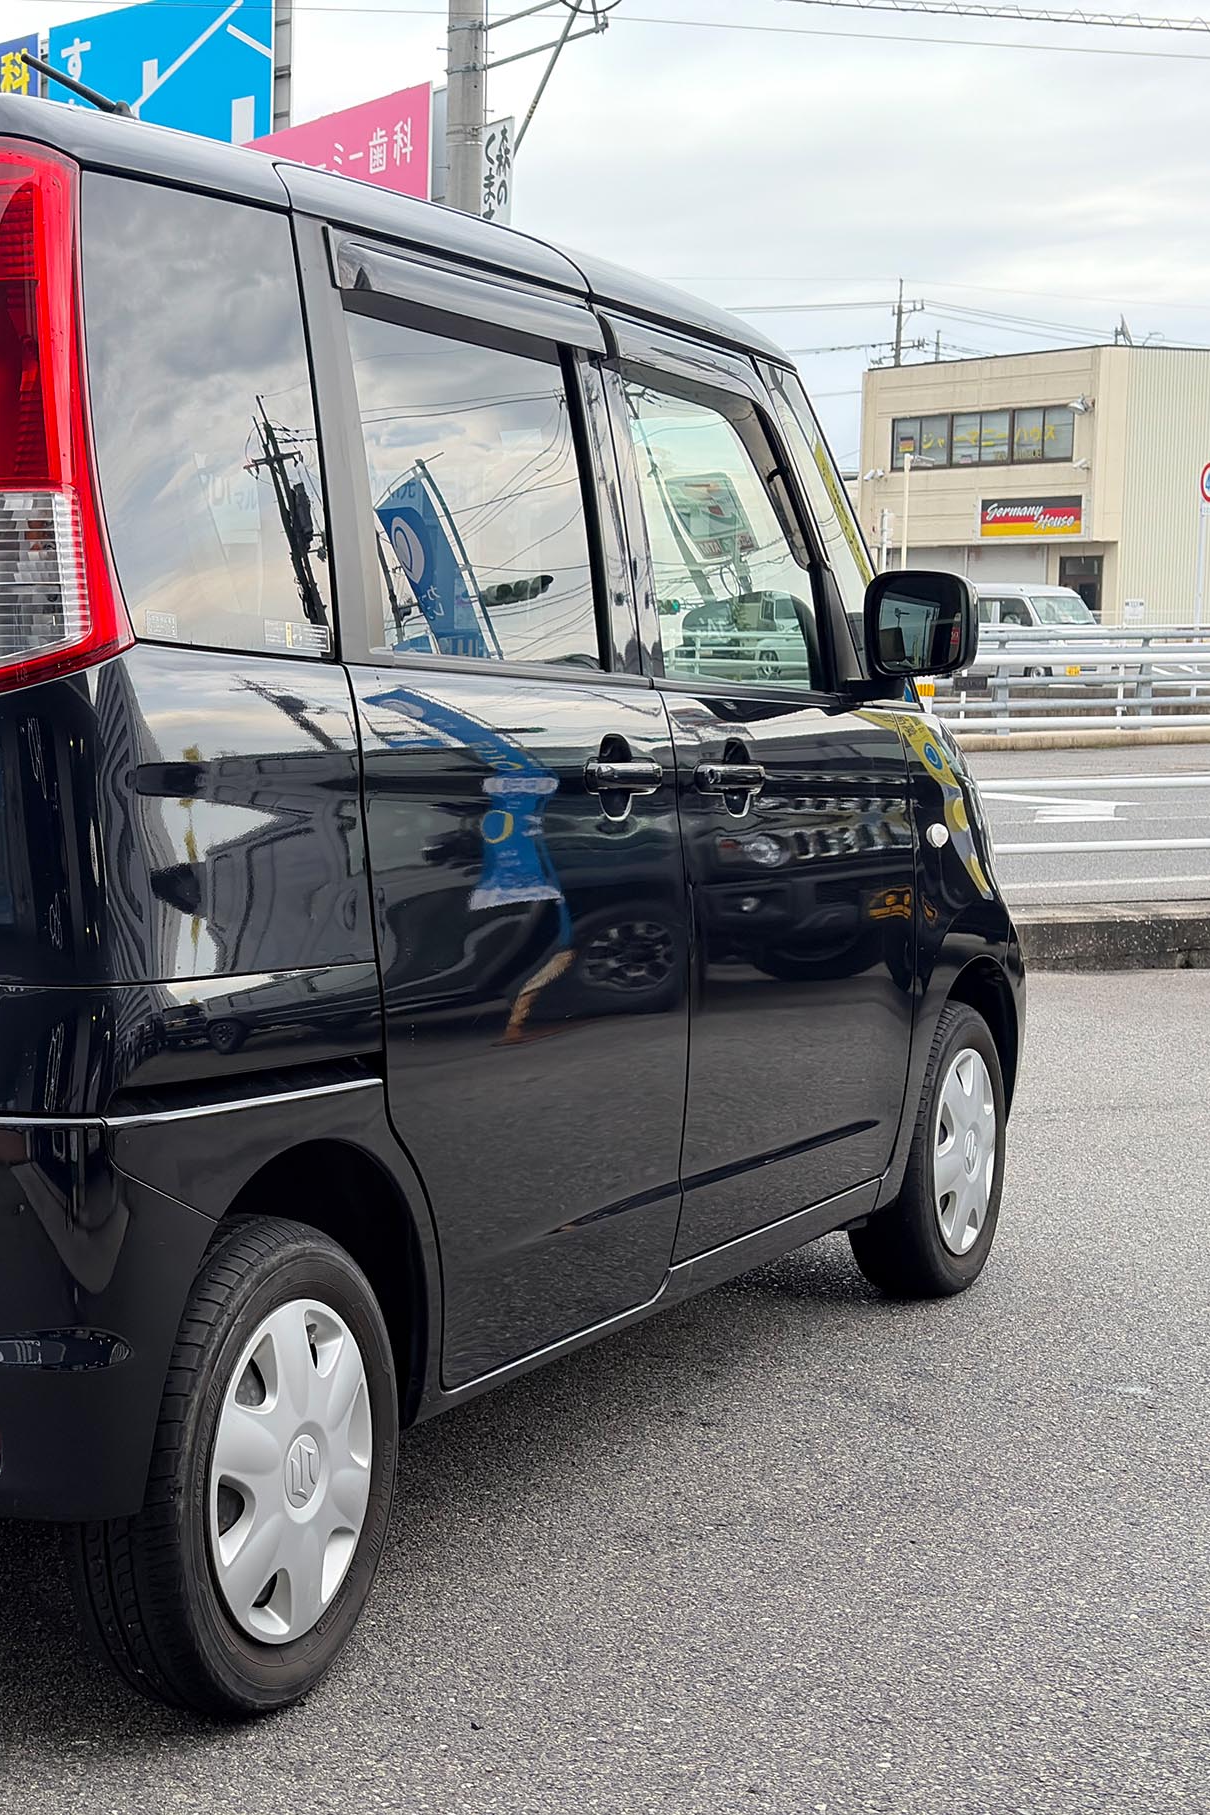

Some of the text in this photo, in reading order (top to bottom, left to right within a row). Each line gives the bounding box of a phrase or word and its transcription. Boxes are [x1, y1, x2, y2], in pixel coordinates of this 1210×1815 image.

[300, 117, 413, 174] ミー歯科
[986, 502, 1043, 520] Germany
[1034, 514, 1075, 530] House
